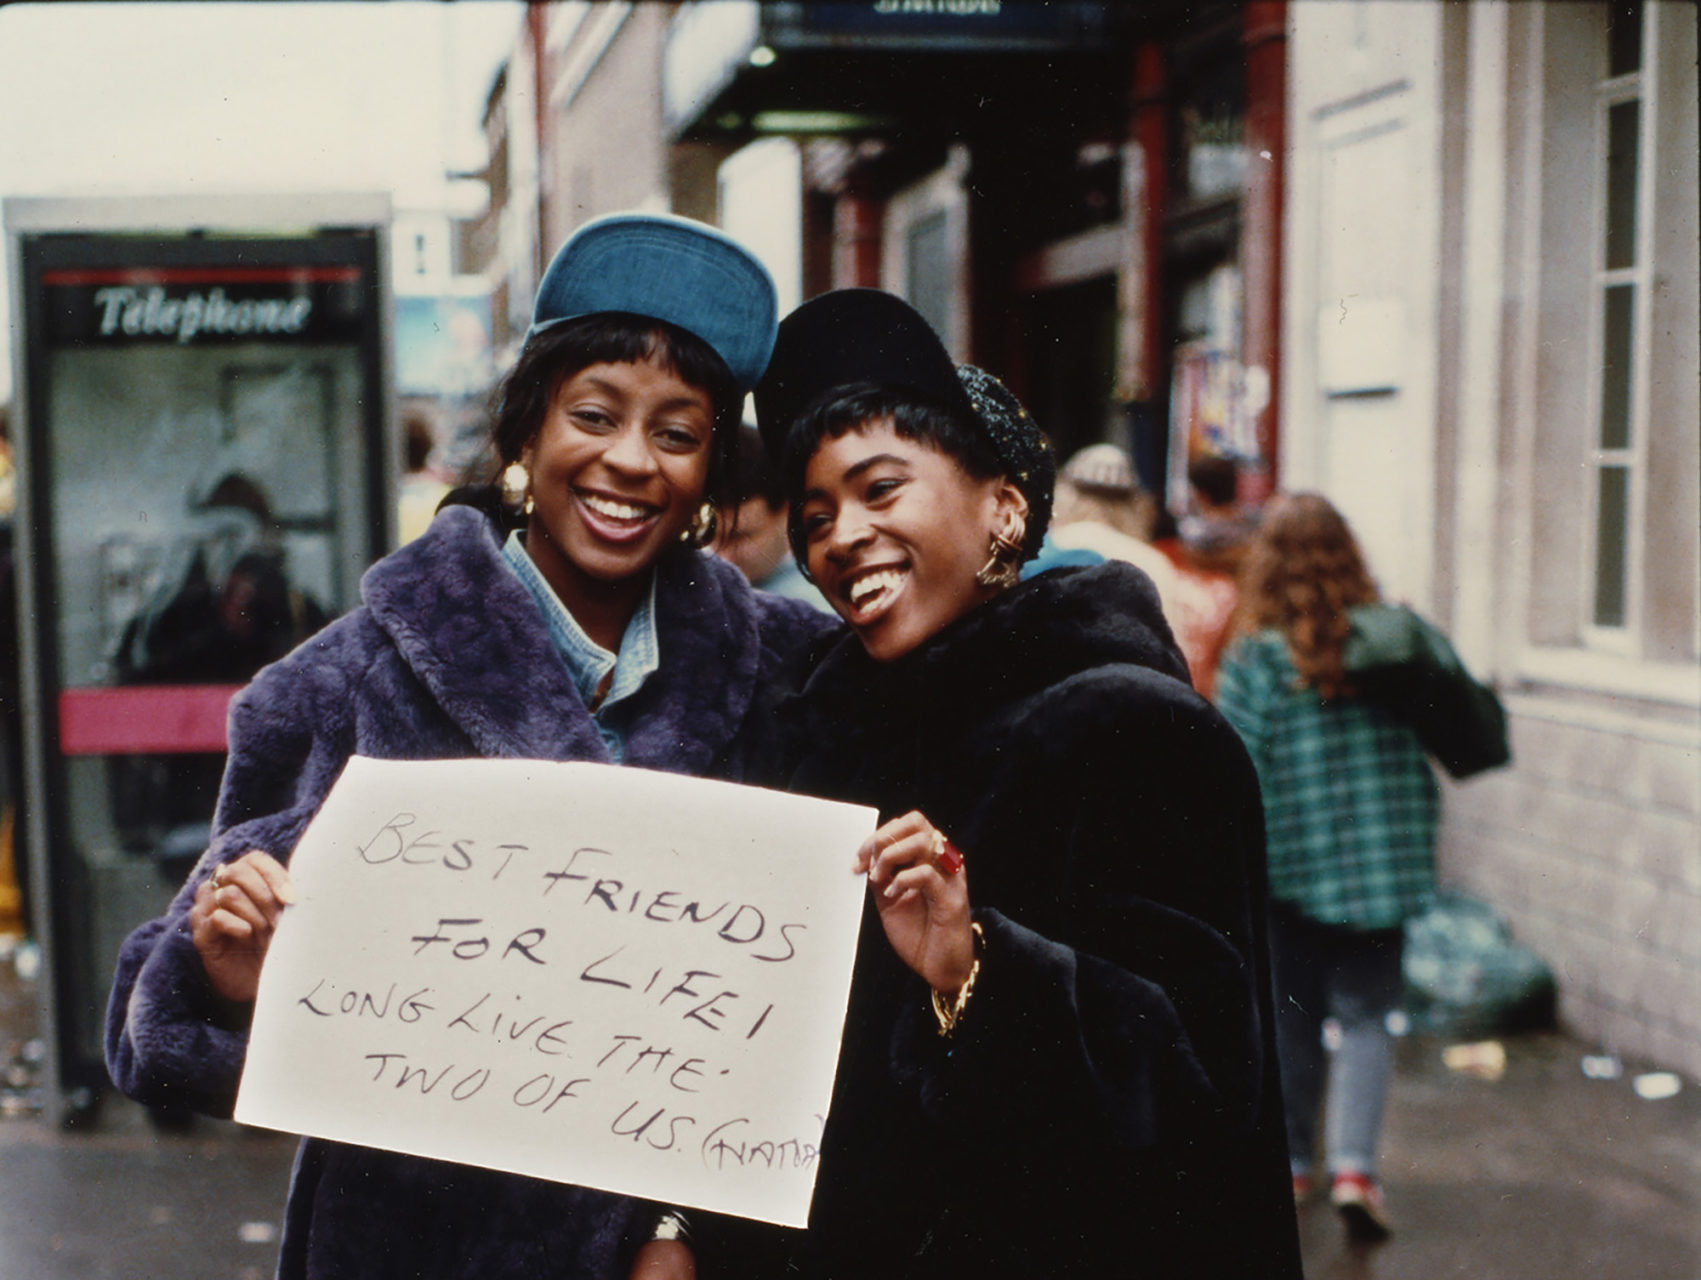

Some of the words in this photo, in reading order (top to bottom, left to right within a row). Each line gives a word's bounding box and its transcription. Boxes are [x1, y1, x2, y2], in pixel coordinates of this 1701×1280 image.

[94, 286, 313, 344] Telephone
[357, 812, 529, 880] BEST
[542, 847, 808, 962] FRIENDS
[411, 918, 548, 965] FOR
[298, 978, 436, 1023] LONG
[365, 1053, 492, 1102] TWO
[512, 1073, 592, 1114] OF
